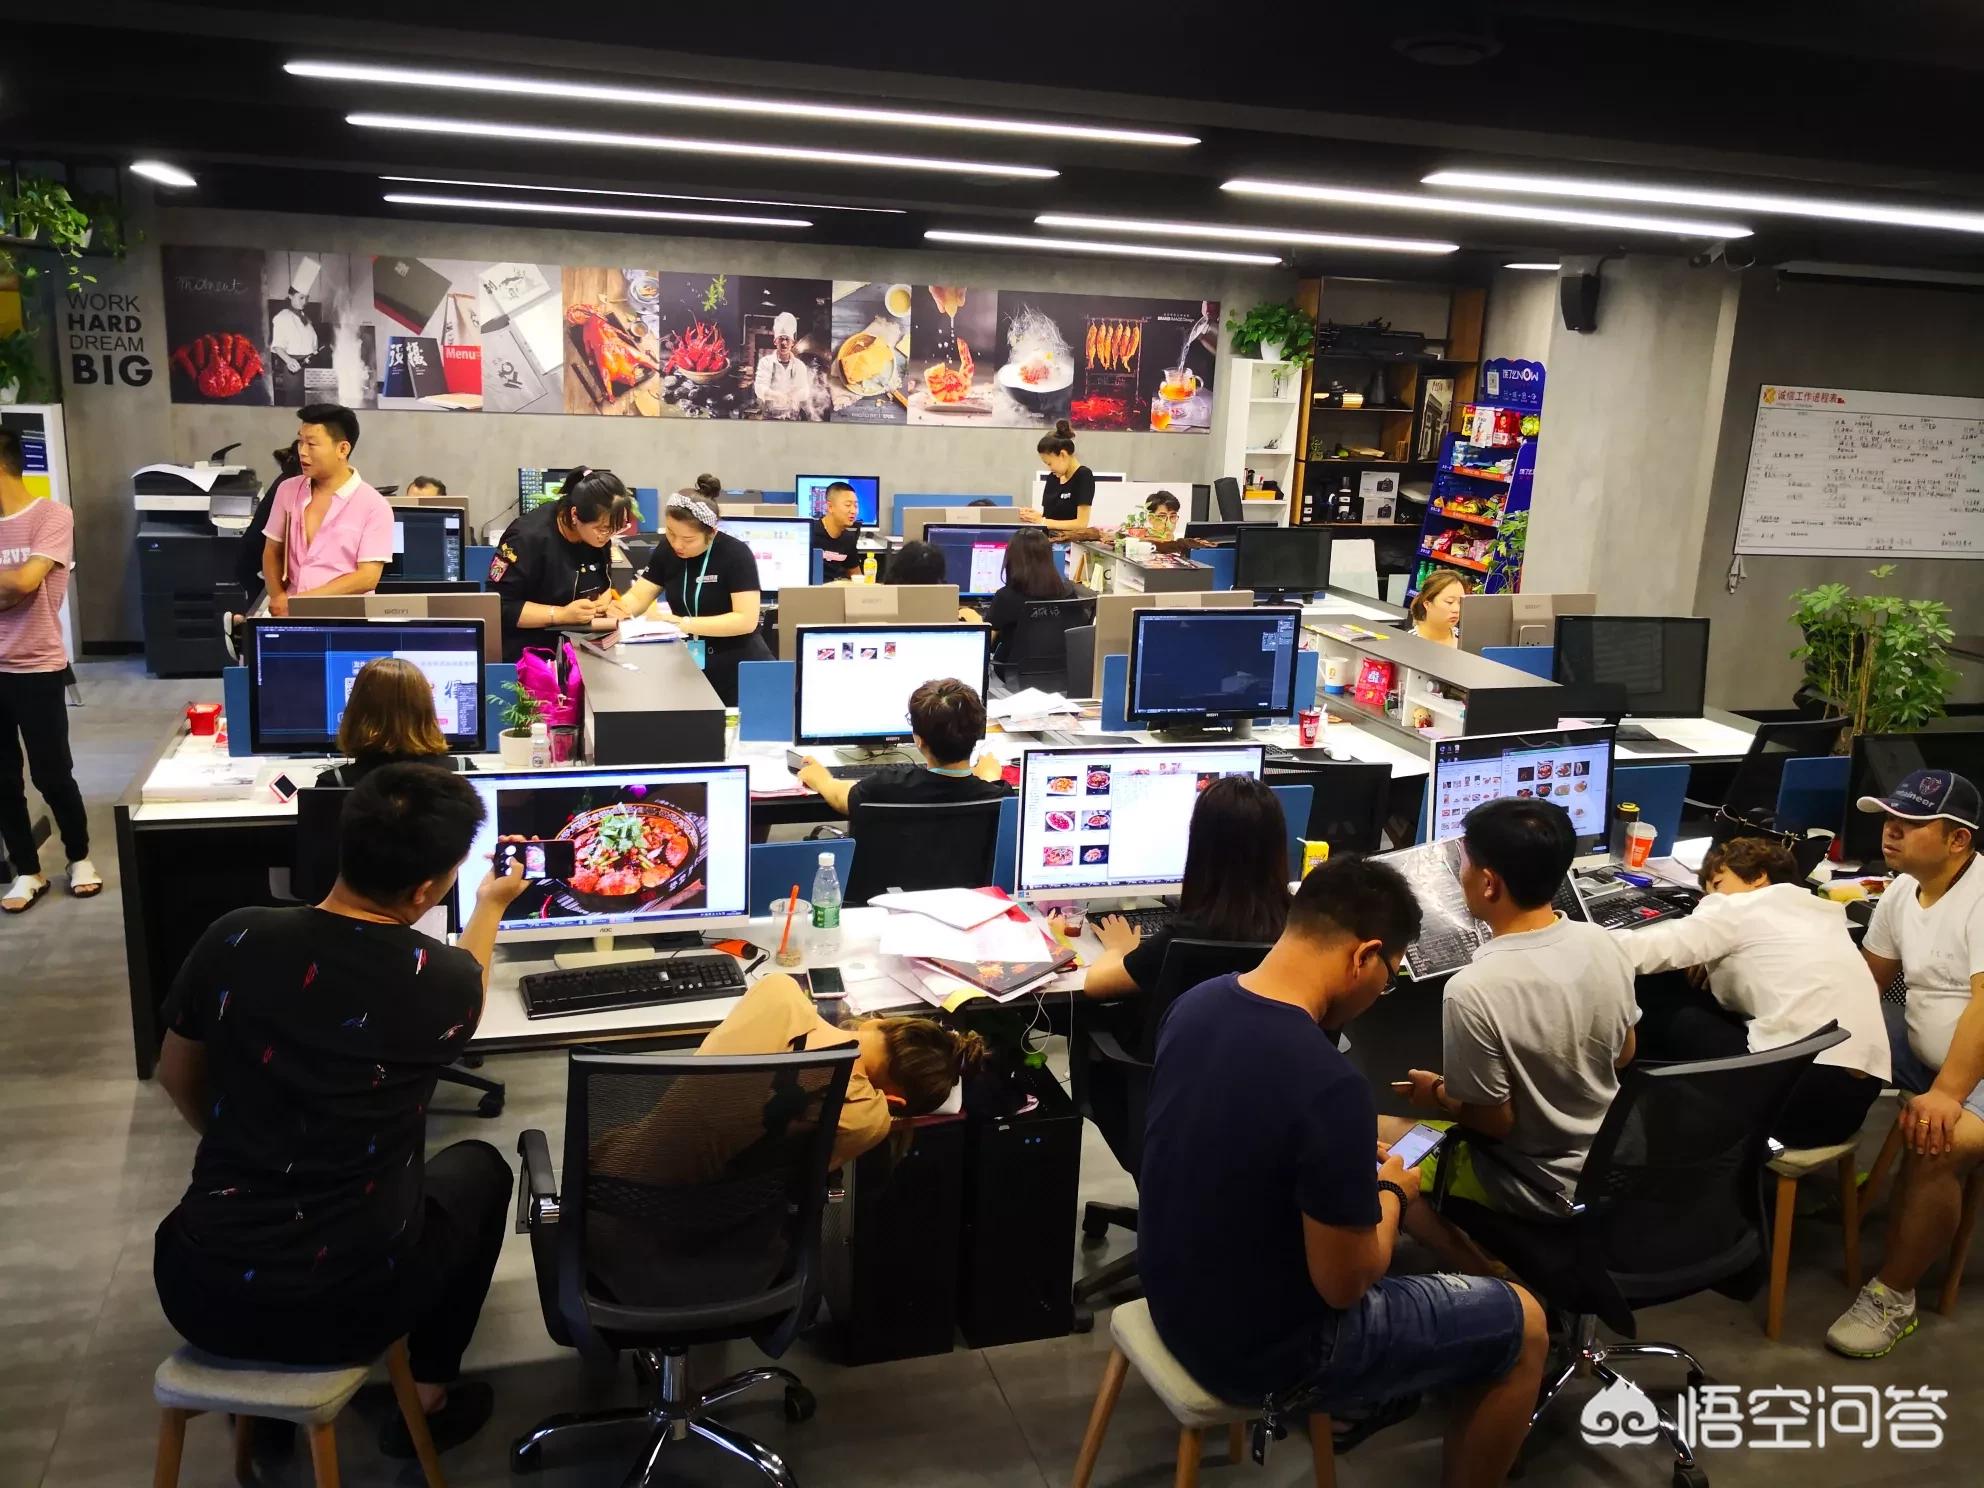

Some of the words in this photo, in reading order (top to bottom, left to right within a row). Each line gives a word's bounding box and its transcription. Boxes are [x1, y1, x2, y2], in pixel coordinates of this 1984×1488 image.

[67, 294, 141, 312] WORK
[67, 313, 142, 333] HARD
[69, 334, 144, 352] DREAM
[445, 347, 477, 360] Menu
[72, 354, 153, 387] BIG
[1777, 390, 1838, 404] 诚信工作进程表
